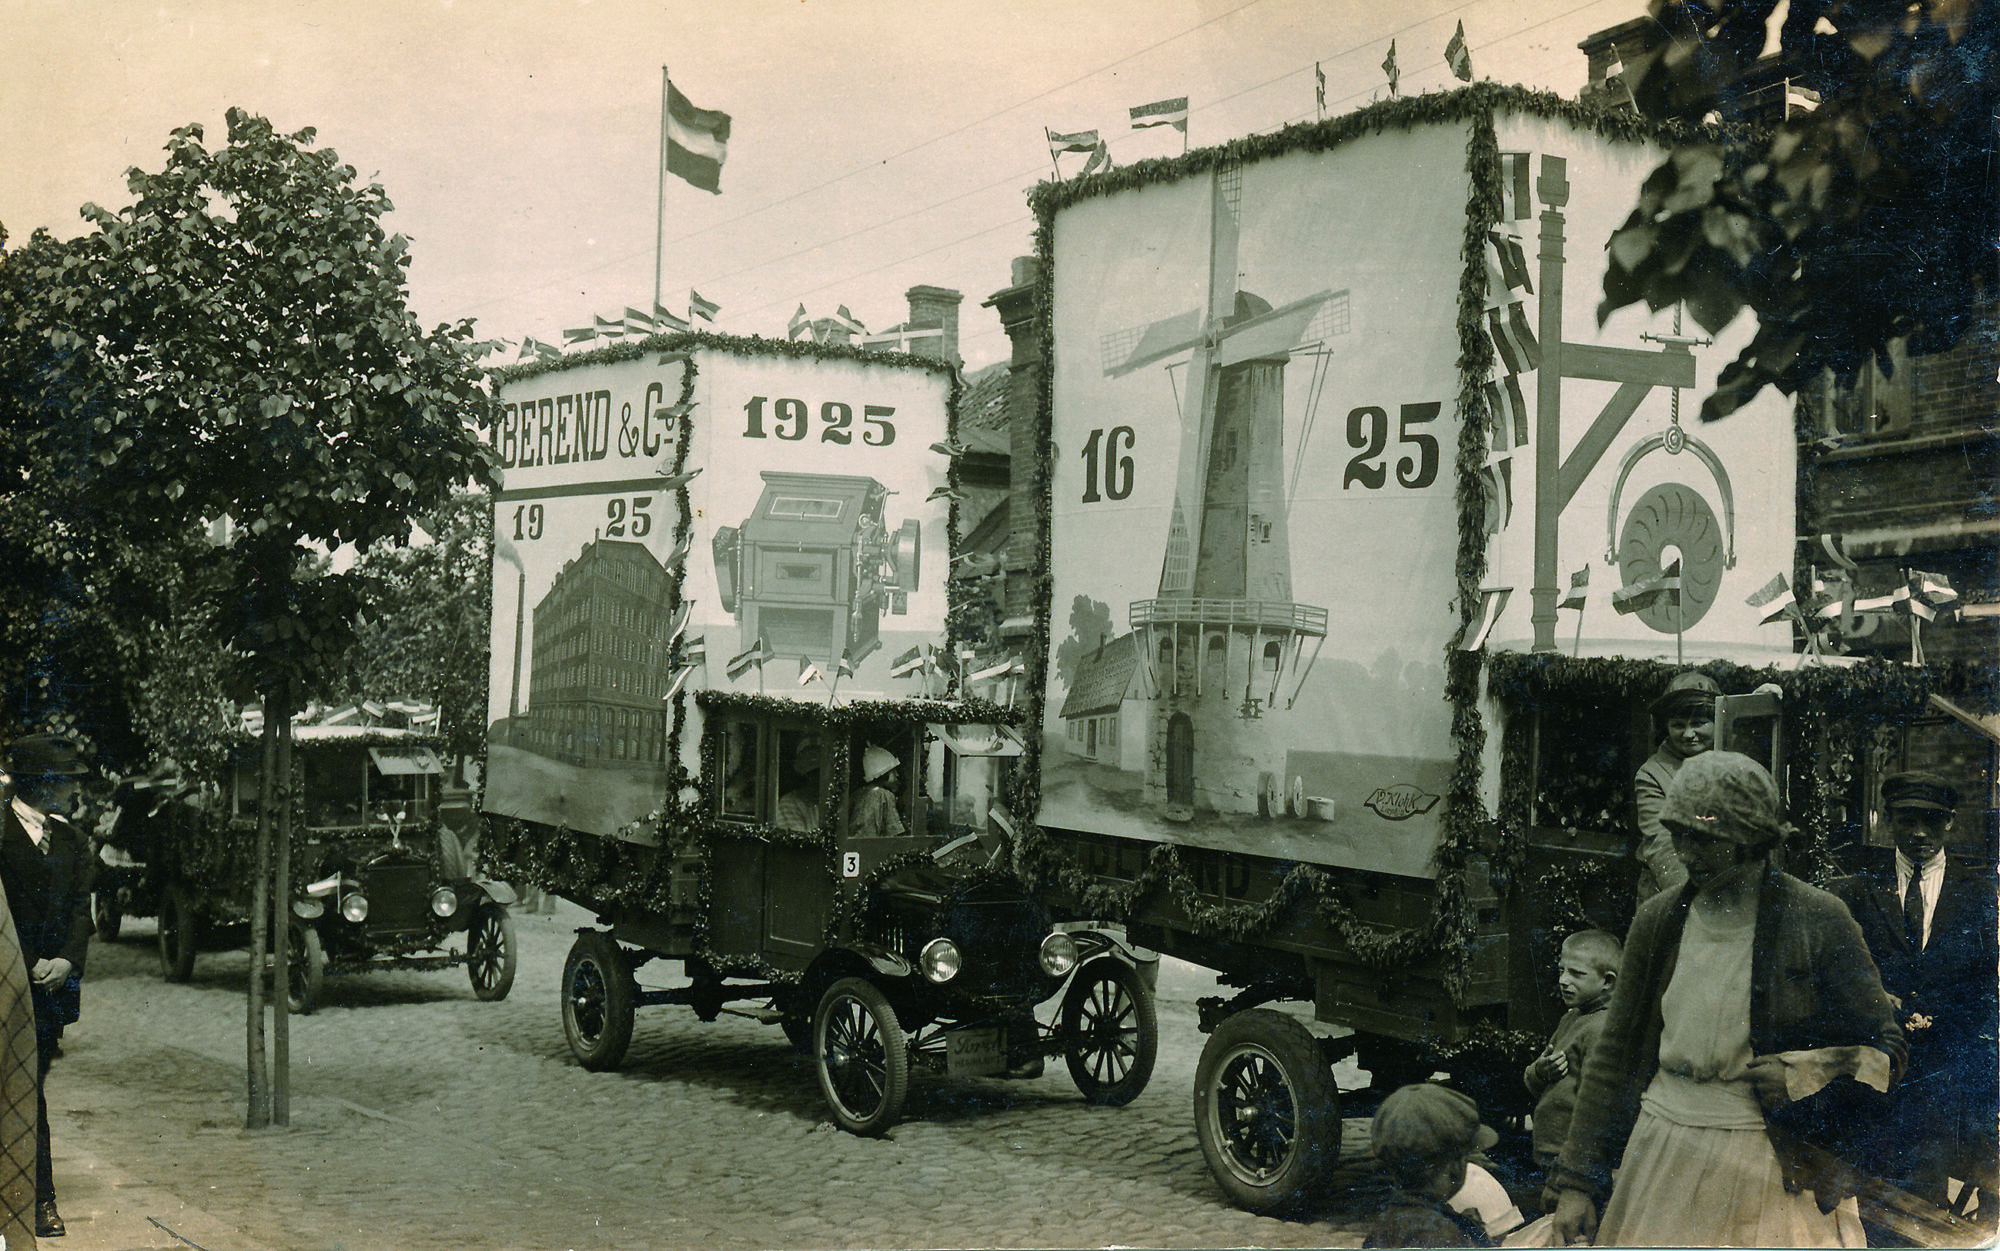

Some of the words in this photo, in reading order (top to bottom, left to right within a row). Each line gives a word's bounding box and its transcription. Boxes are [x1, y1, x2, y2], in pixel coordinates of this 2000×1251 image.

[502, 389, 611, 469] BEREND
[742, 396, 896, 446] 1925
[1081, 425, 1135, 503] 16
[1343, 401, 1441, 490] 25
[513, 504, 544, 541] 19
[606, 497, 652, 537] 25
[847, 857, 856, 872] 3
